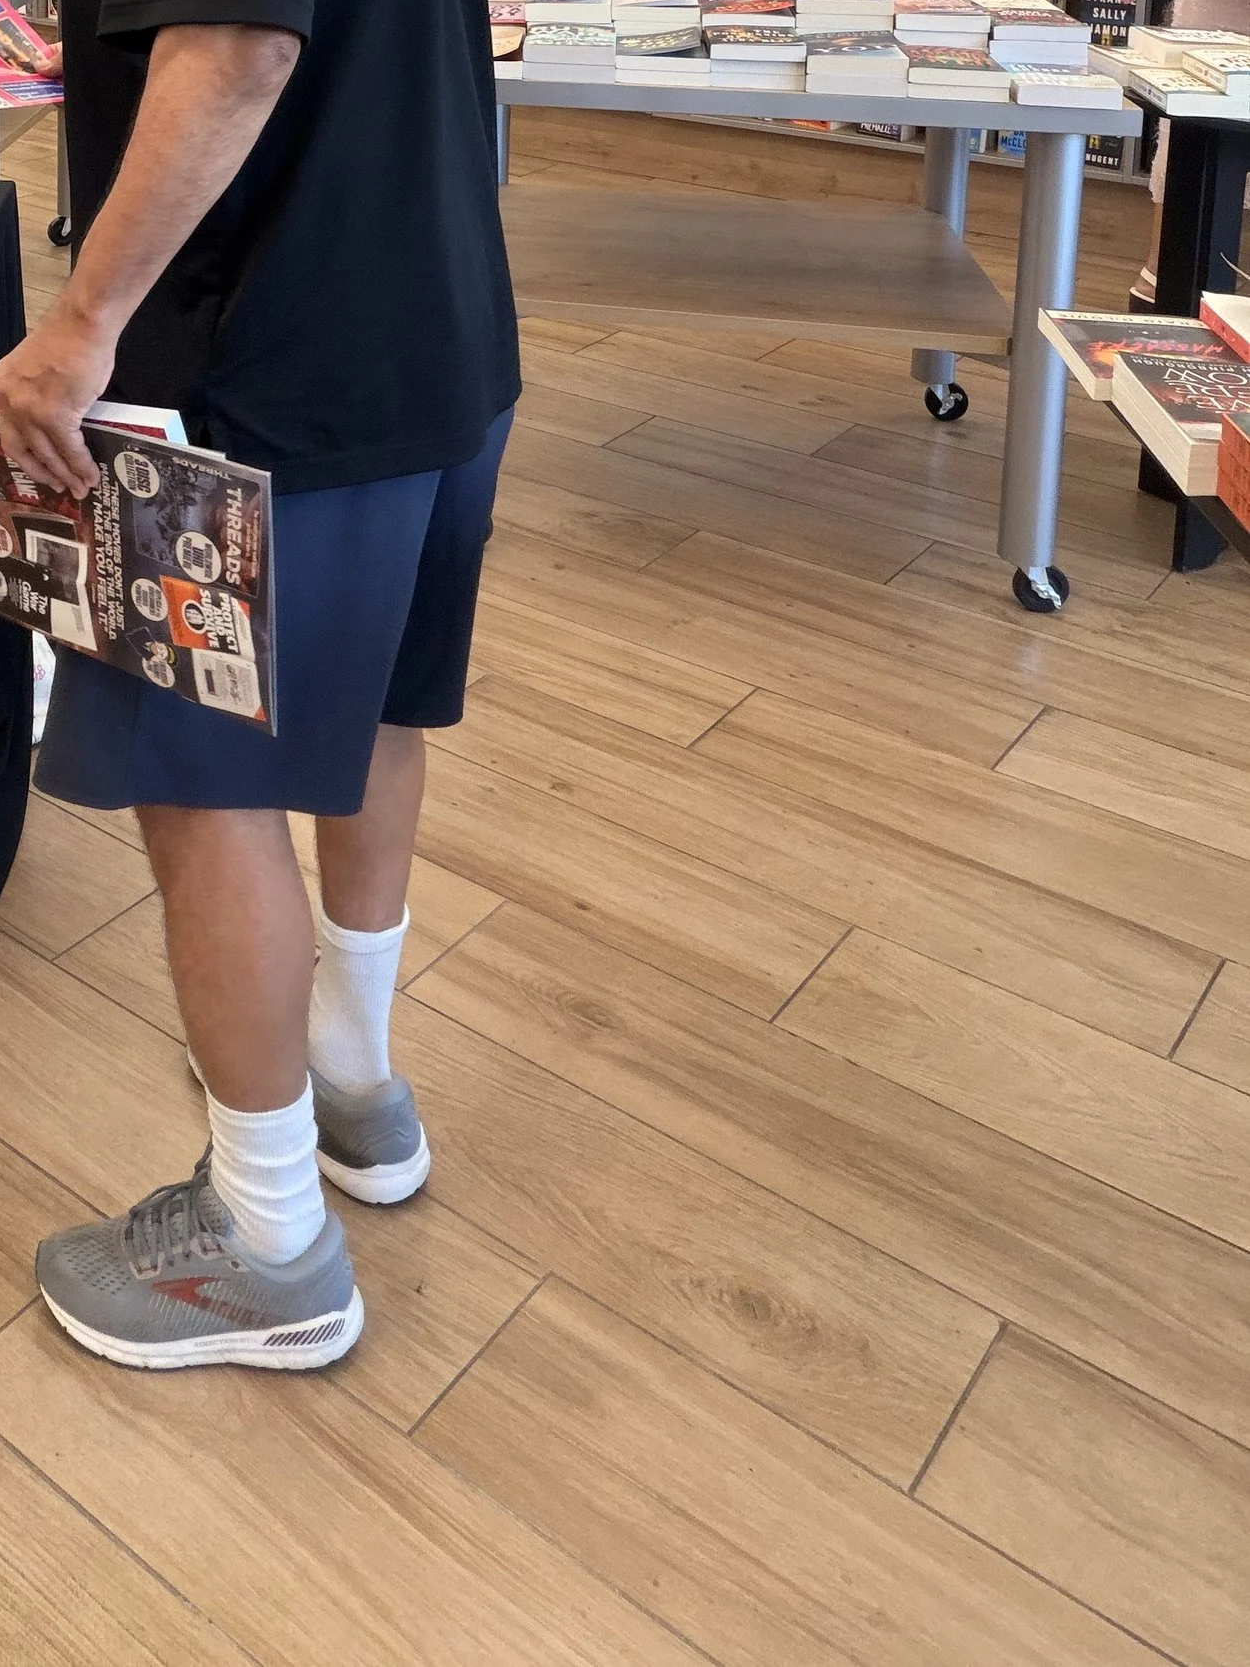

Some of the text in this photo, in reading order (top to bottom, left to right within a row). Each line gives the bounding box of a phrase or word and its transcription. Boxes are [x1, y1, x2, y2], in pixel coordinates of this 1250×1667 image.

[1093, 7, 1127, 21] SALLY
[10, 471, 39, 500] GAME
[123, 453, 136, 492] COLLECTION
[135, 459, 151, 493] 3 DISC
[93, 502, 104, 541] MAKE
[225, 488, 242, 584] THREADS
[96, 543, 106, 574] YOU
[99, 462, 117, 640] IMAGINE THE END OF THE WORLD.
[112, 523, 121, 564] MOVIES
[21, 580, 30, 613] Game
[97, 576, 107, 608] FEEL
[114, 566, 123, 600] DON'T
[30, 591, 38, 612] War
[37, 595, 48, 614] The
[116, 601, 125, 630] JUST
[199, 588, 220, 649] SURVIVE
[212, 605, 225, 635] AND
[219, 592, 239, 654] PROTECT
